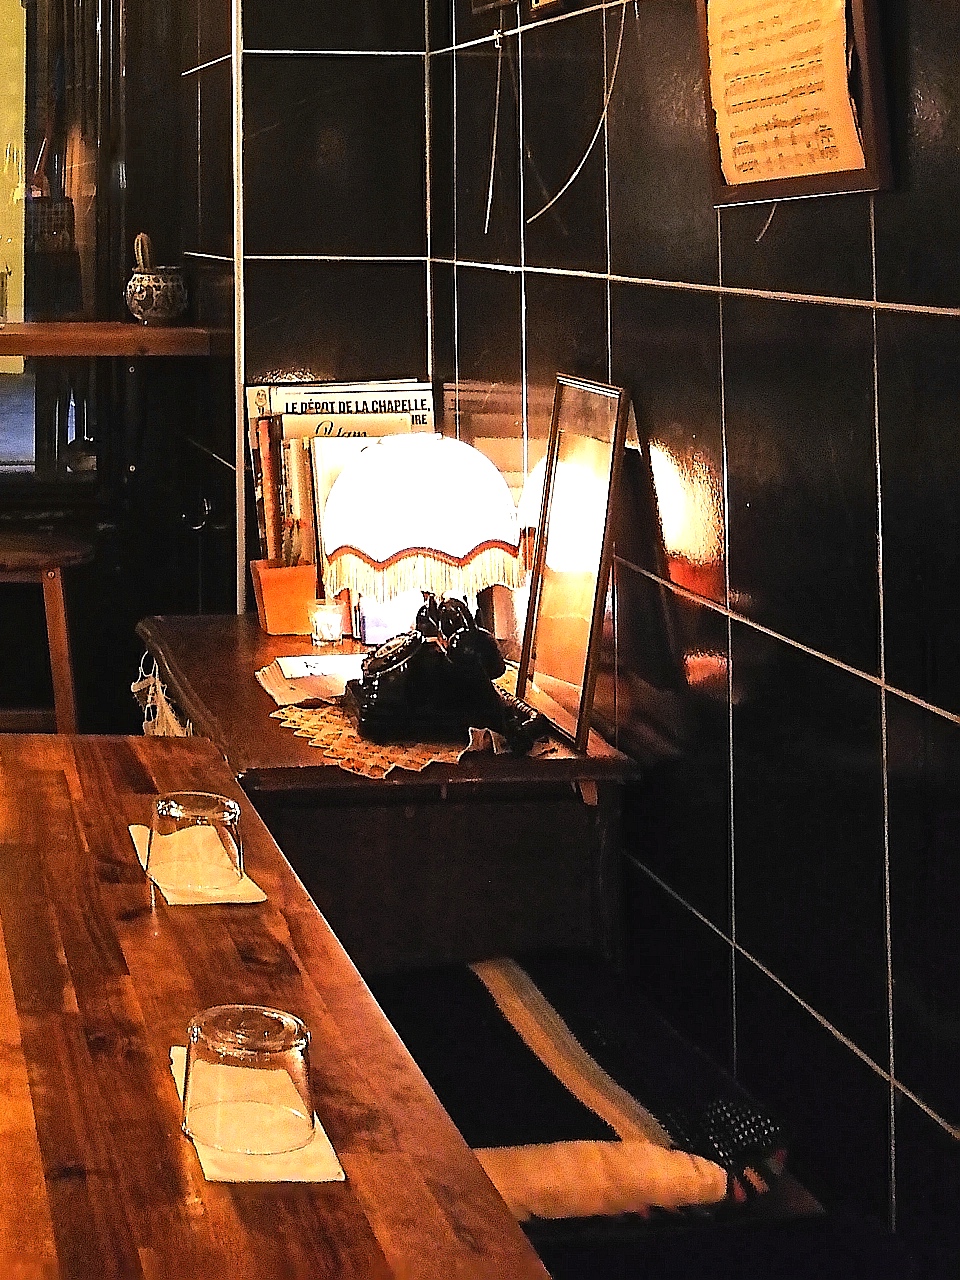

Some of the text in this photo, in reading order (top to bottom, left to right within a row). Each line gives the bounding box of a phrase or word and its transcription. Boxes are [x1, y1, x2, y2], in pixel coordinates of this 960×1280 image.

[285, 402, 298, 414] LE
[338, 400, 352, 414] DE
[354, 400, 369, 413] LA
[371, 398, 431, 413] CHAPELLE,
